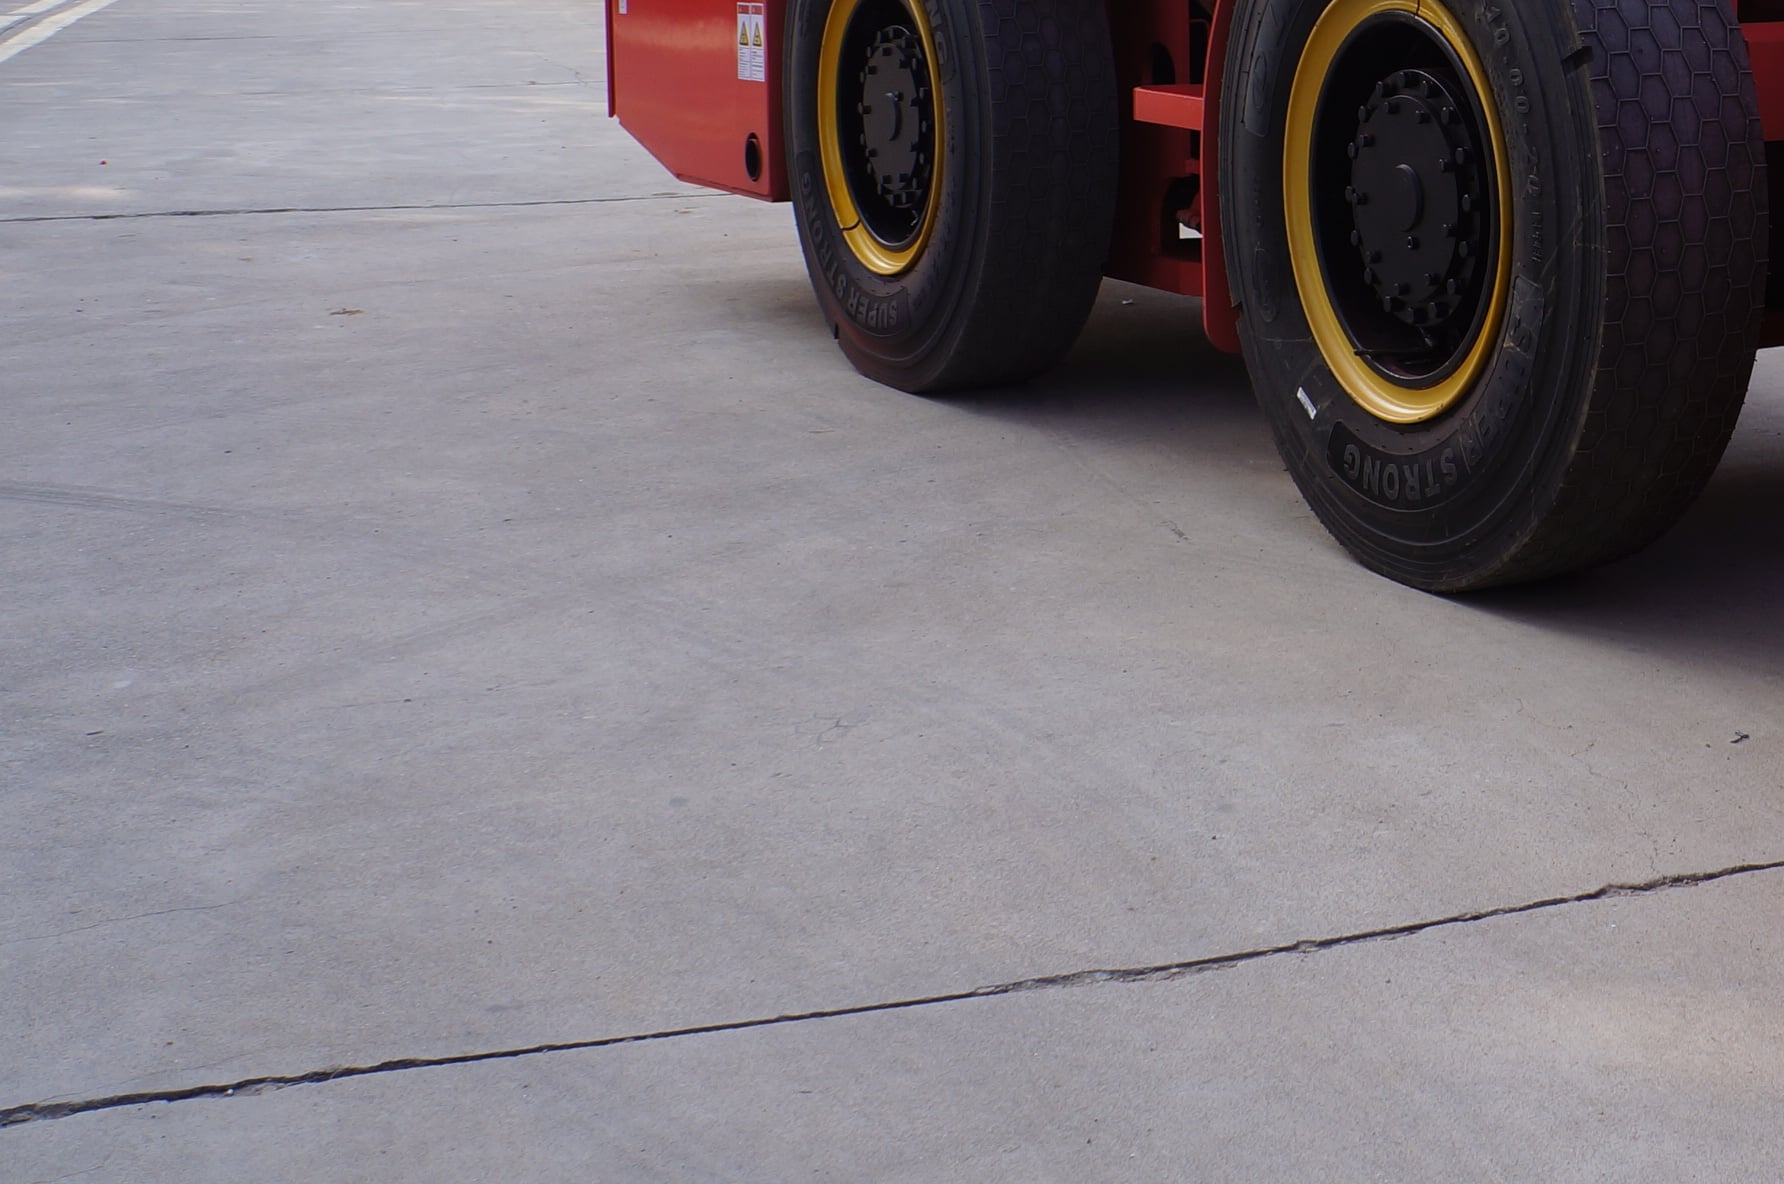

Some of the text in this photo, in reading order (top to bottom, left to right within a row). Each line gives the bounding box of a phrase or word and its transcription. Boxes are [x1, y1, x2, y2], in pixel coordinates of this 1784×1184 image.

[800, 172, 898, 329] SUPER STRONG
[1343, 444, 1458, 502] STRONG
